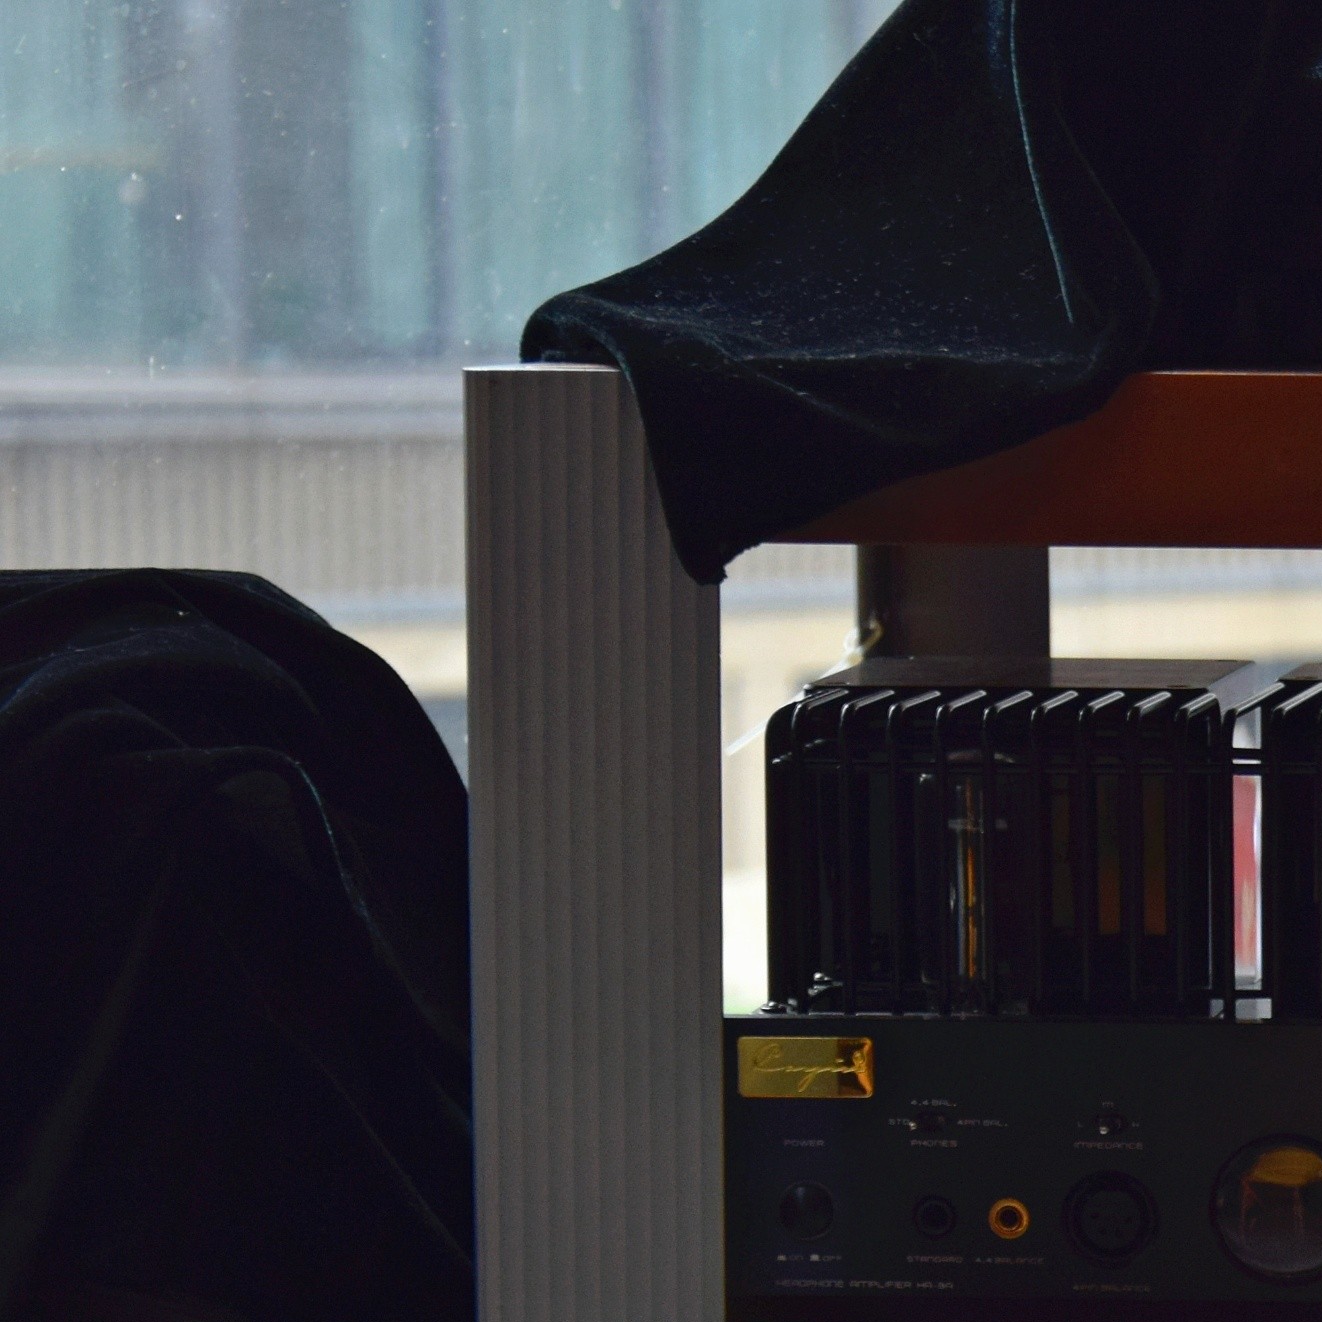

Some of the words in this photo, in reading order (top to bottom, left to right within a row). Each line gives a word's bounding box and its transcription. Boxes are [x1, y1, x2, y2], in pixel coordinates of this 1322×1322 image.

[782, 1138, 826, 1148] POWER
[910, 1138, 958, 1149] PHONES
[1073, 1140, 1144, 1151] IMPEDANCE
[905, 1254, 963, 1264] STANDARD
[775, 1278, 845, 1289] HEADPHONE
[848, 1279, 913, 1290] AMPLIFIER
